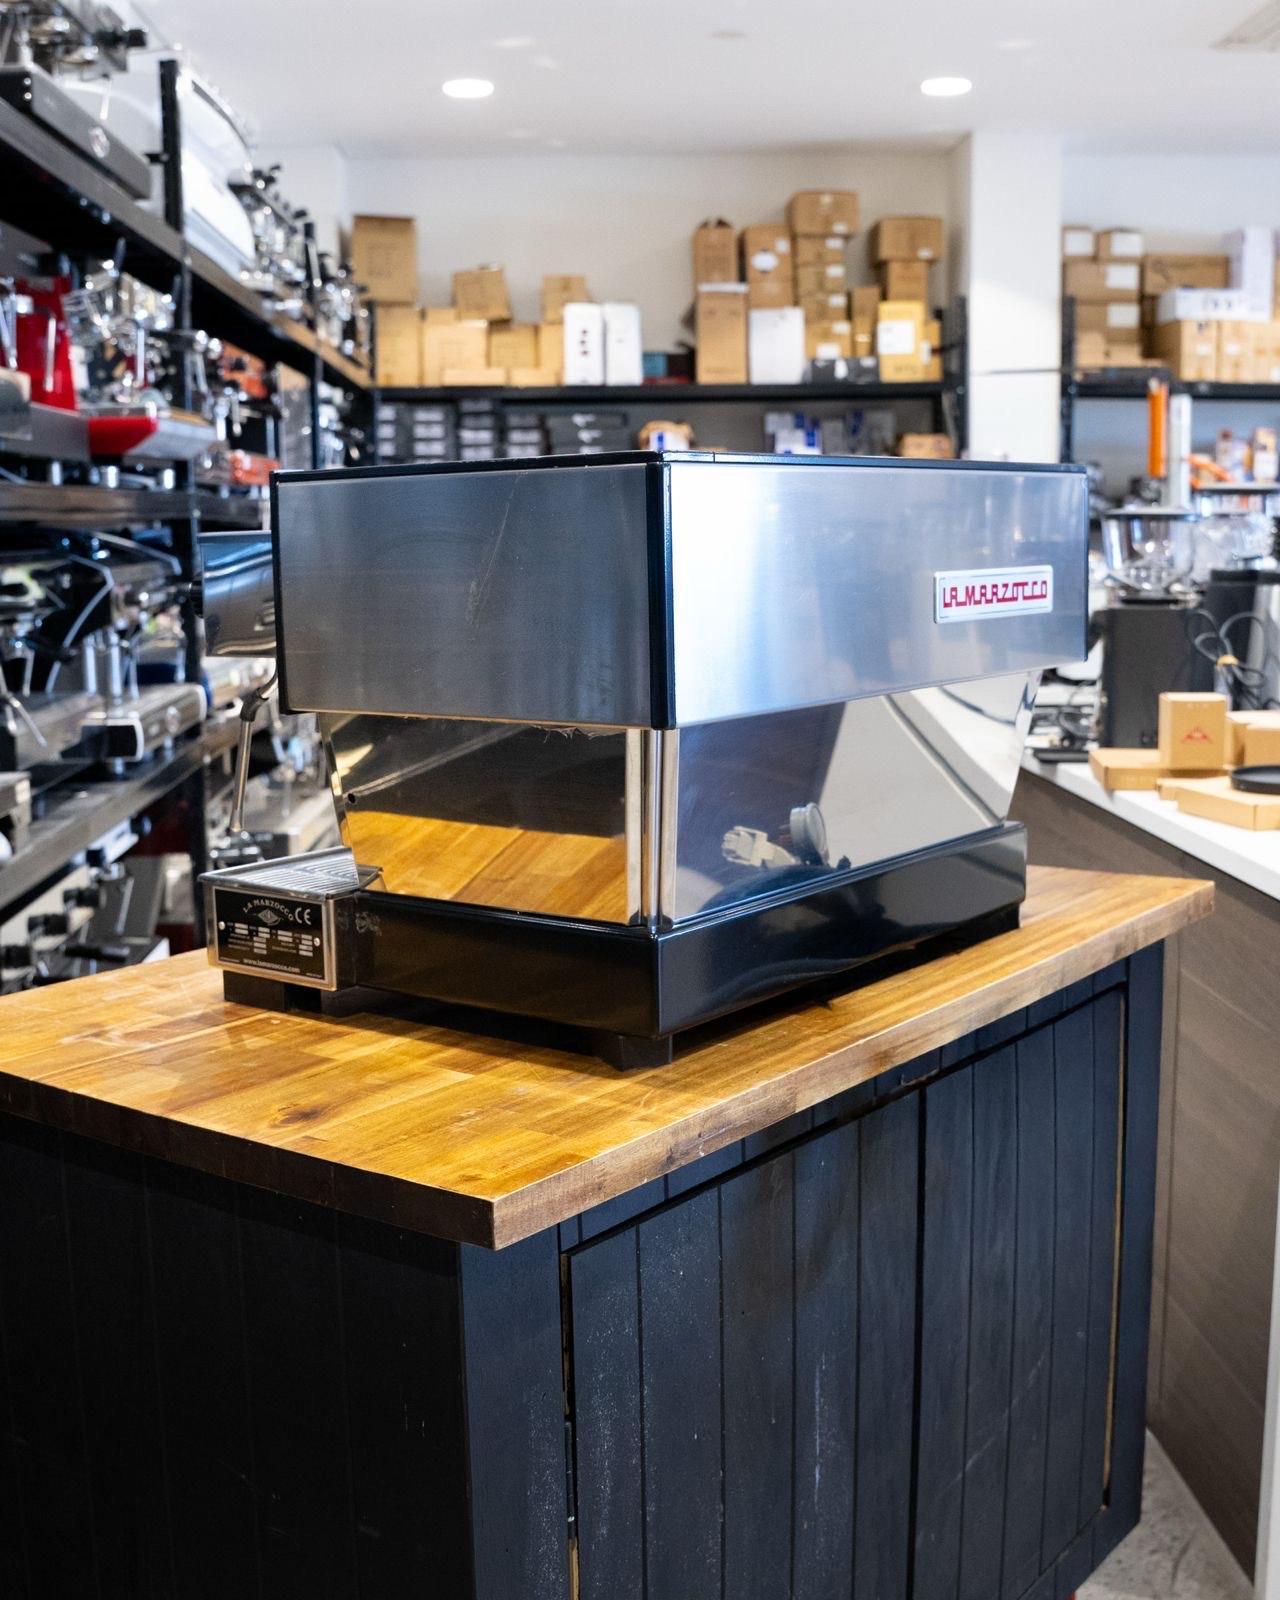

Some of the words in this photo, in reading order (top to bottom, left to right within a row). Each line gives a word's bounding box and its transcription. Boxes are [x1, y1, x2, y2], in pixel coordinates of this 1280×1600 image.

[243, 902, 253, 914] LA
[253, 899, 294, 921] MARZOCCO
[295, 907, 311, 925] CE
